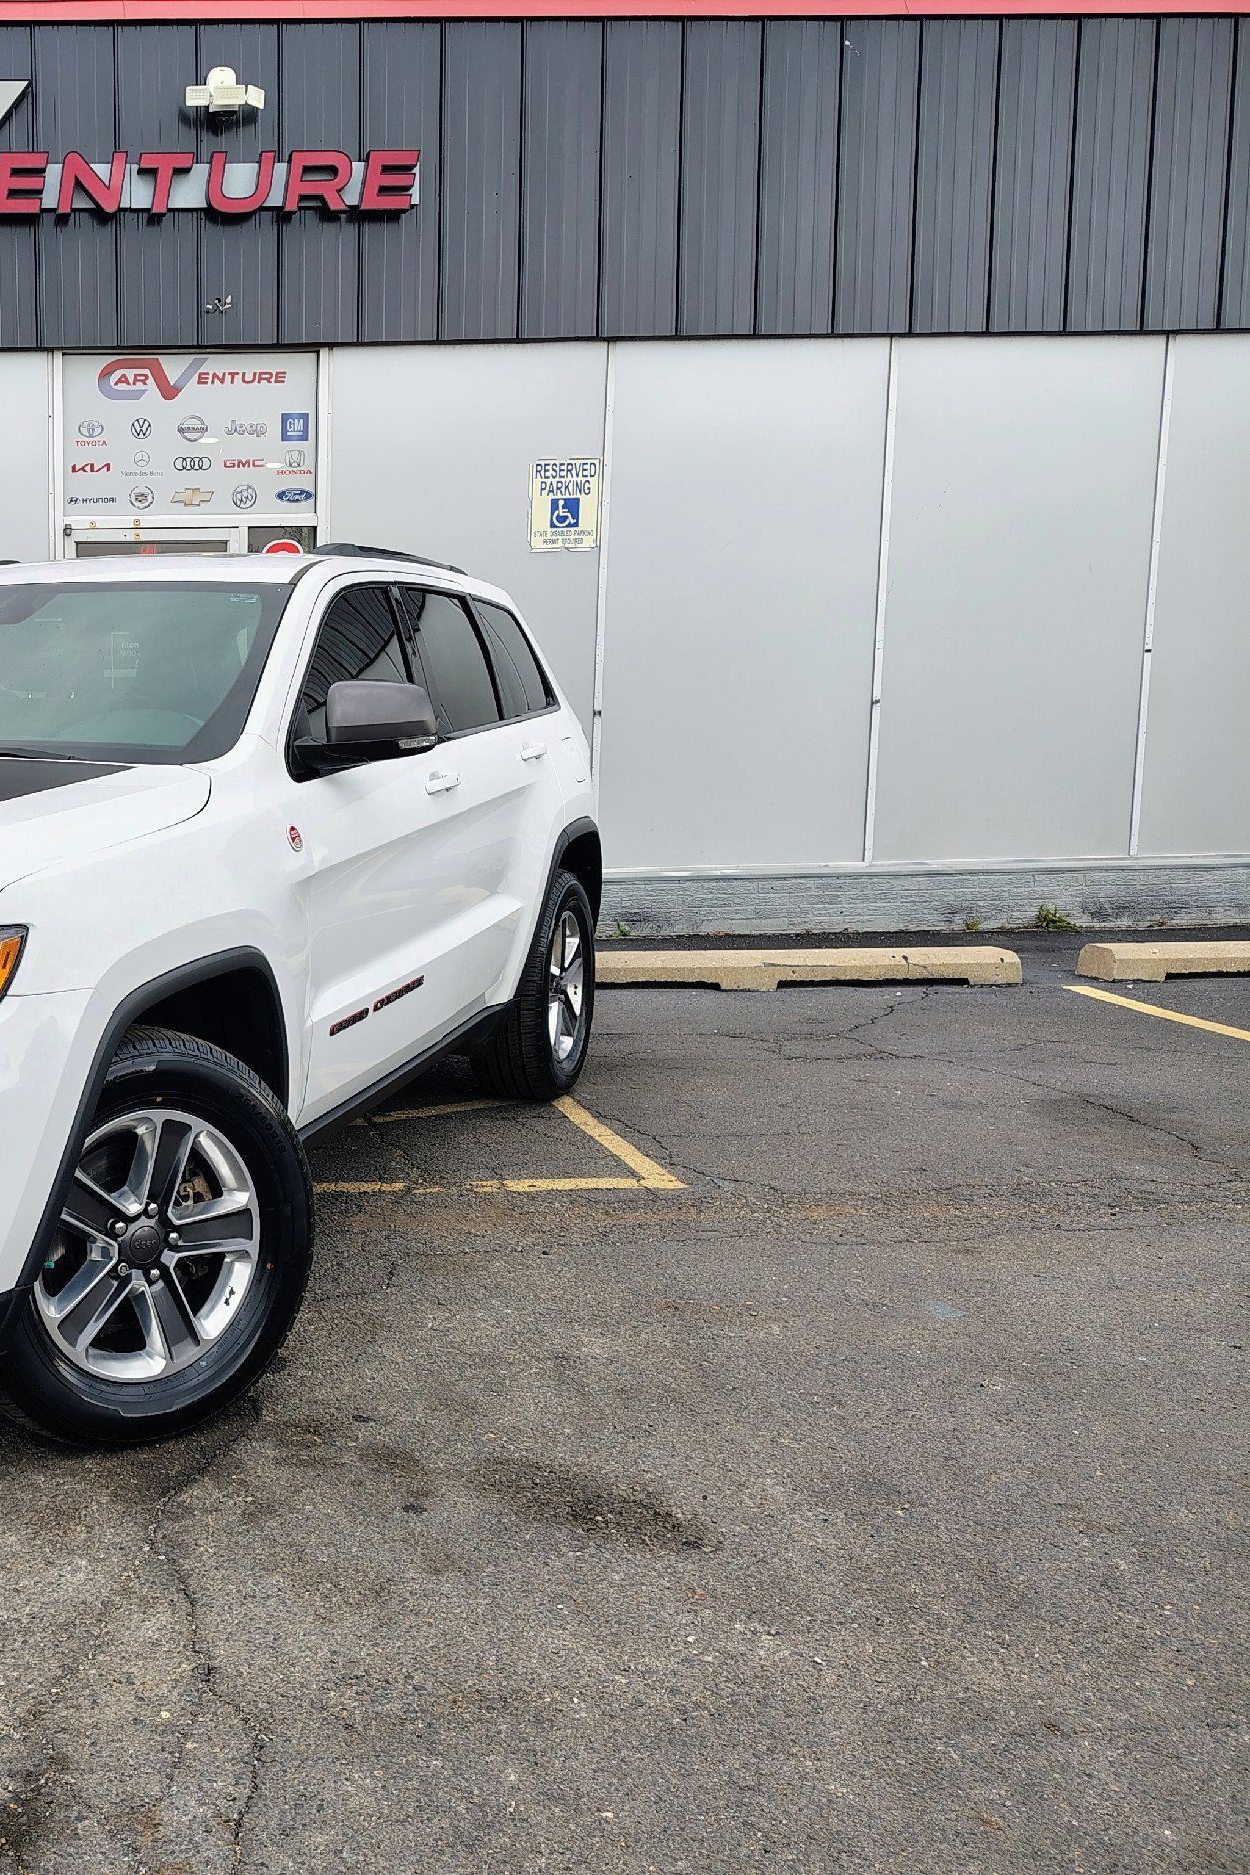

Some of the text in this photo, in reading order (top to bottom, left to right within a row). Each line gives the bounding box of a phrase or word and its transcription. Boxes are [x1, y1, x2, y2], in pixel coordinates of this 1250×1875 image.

[225, 420, 267, 437] Jeep
[287, 418, 304, 431] GM
[71, 463, 110, 473] KIA
[223, 458, 265, 468] GMC
[535, 462, 597, 479] RESERVED
[540, 480, 591, 496] PARKING
[282, 490, 307, 502] Ford
